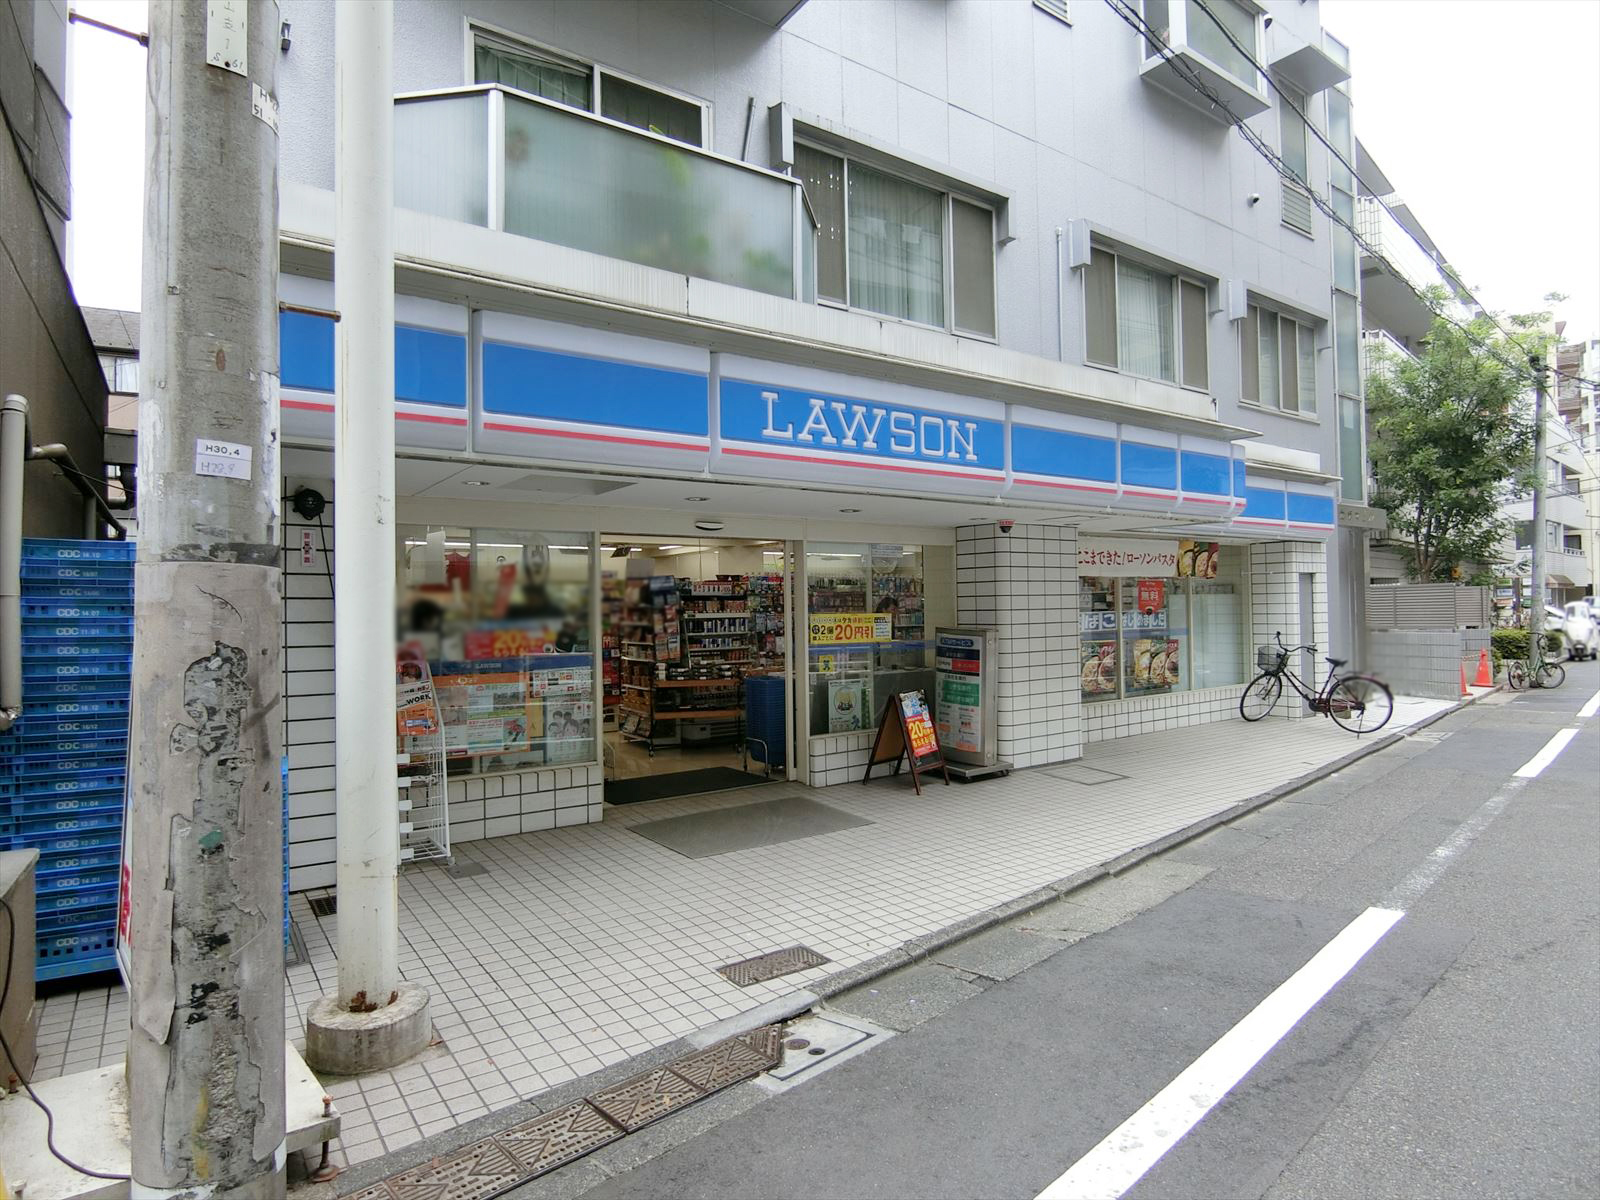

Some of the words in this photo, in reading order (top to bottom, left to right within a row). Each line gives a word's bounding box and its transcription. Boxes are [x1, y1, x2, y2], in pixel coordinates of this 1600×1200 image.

[761, 391, 977, 461] LAWSON
[205, 445, 240, 456] H30.4
[58, 550, 80, 558] CDC
[57, 666, 80, 674] CDC
[56, 684, 78, 692] CDC
[56, 704, 79, 712] CDC
[58, 723, 80, 731] CDC
[909, 721, 923, 740] 20
[58, 742, 80, 750] CDC
[56, 781, 78, 790] CDC
[56, 801, 79, 809] CDC
[56, 820, 79, 830] CDC
[56, 840, 79, 848] CDC
[56, 859, 79, 868] CDC
[57, 878, 80, 887] CDC
[57, 897, 79, 906] CDC
[57, 937, 79, 947] CDC
